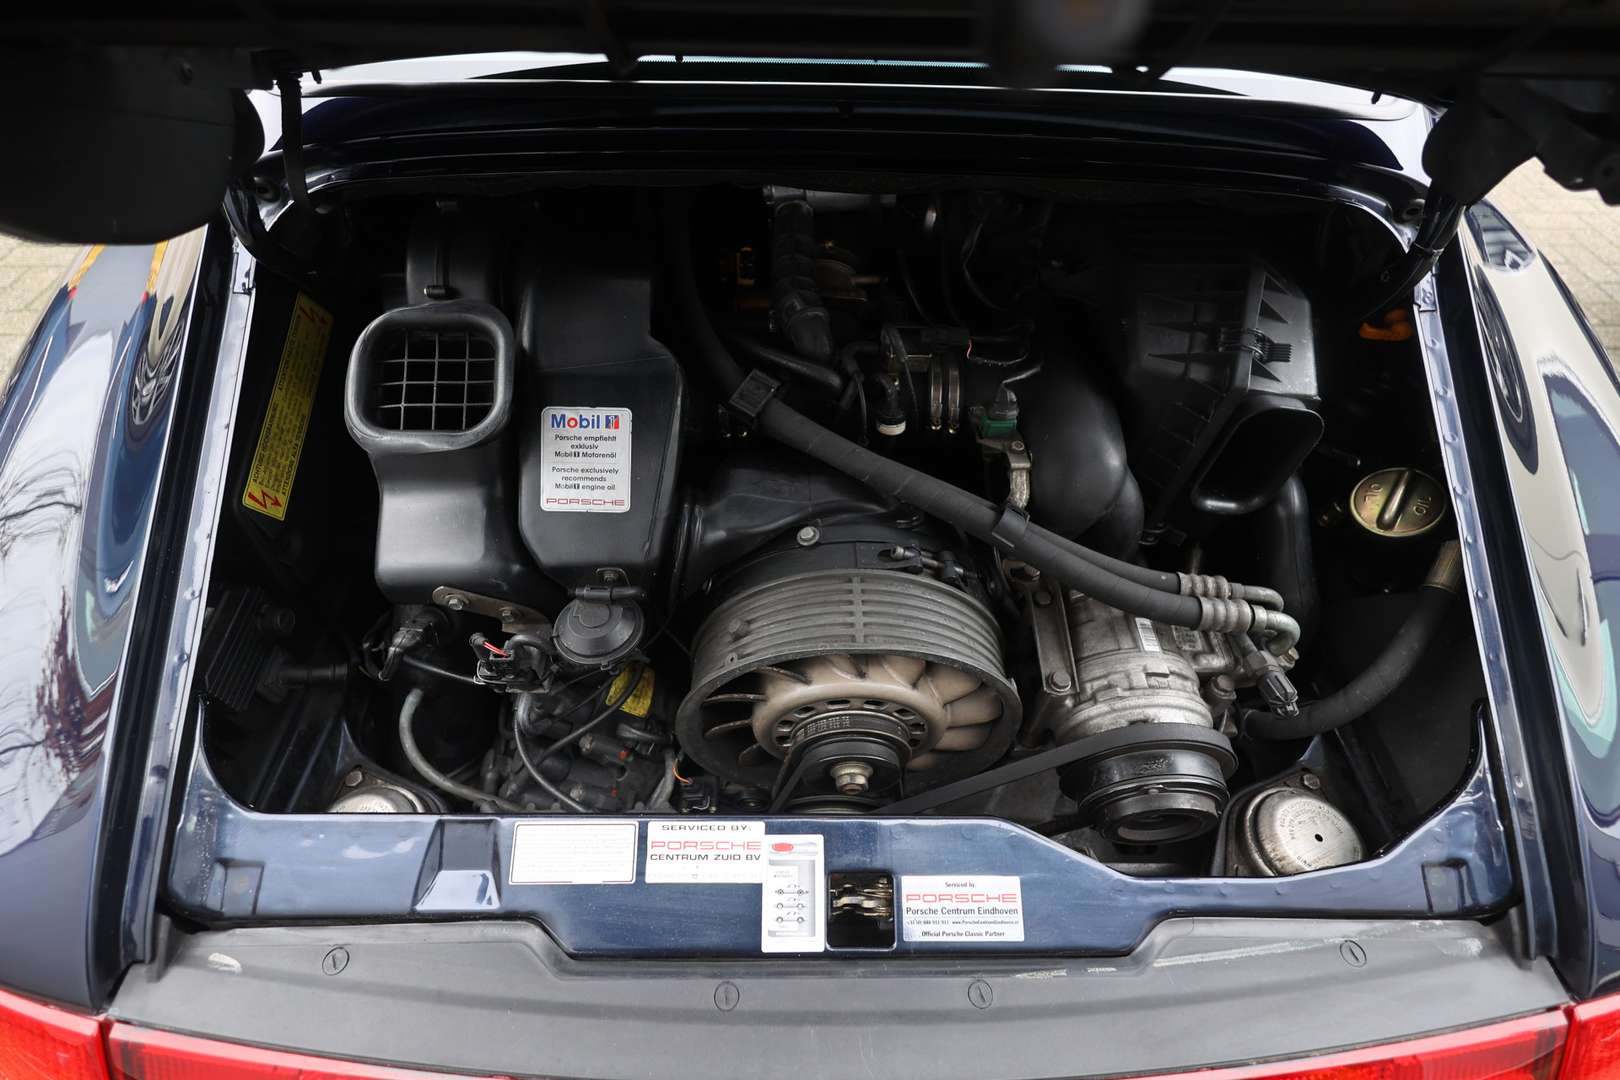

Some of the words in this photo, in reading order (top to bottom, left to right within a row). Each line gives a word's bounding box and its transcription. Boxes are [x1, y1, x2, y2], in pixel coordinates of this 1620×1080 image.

[552, 414, 600, 429] Mobil
[584, 434, 617, 443] empfiehlt
[580, 467, 619, 475] exclusively
[546, 498, 625, 506] PORSCHE
[651, 841, 761, 850] PORSCHE
[906, 894, 1017, 903] PORSCHE
[906, 906, 939, 915] Porsche
[941, 906, 975, 915] Centrum
[978, 906, 1019, 915] Eindhoven
